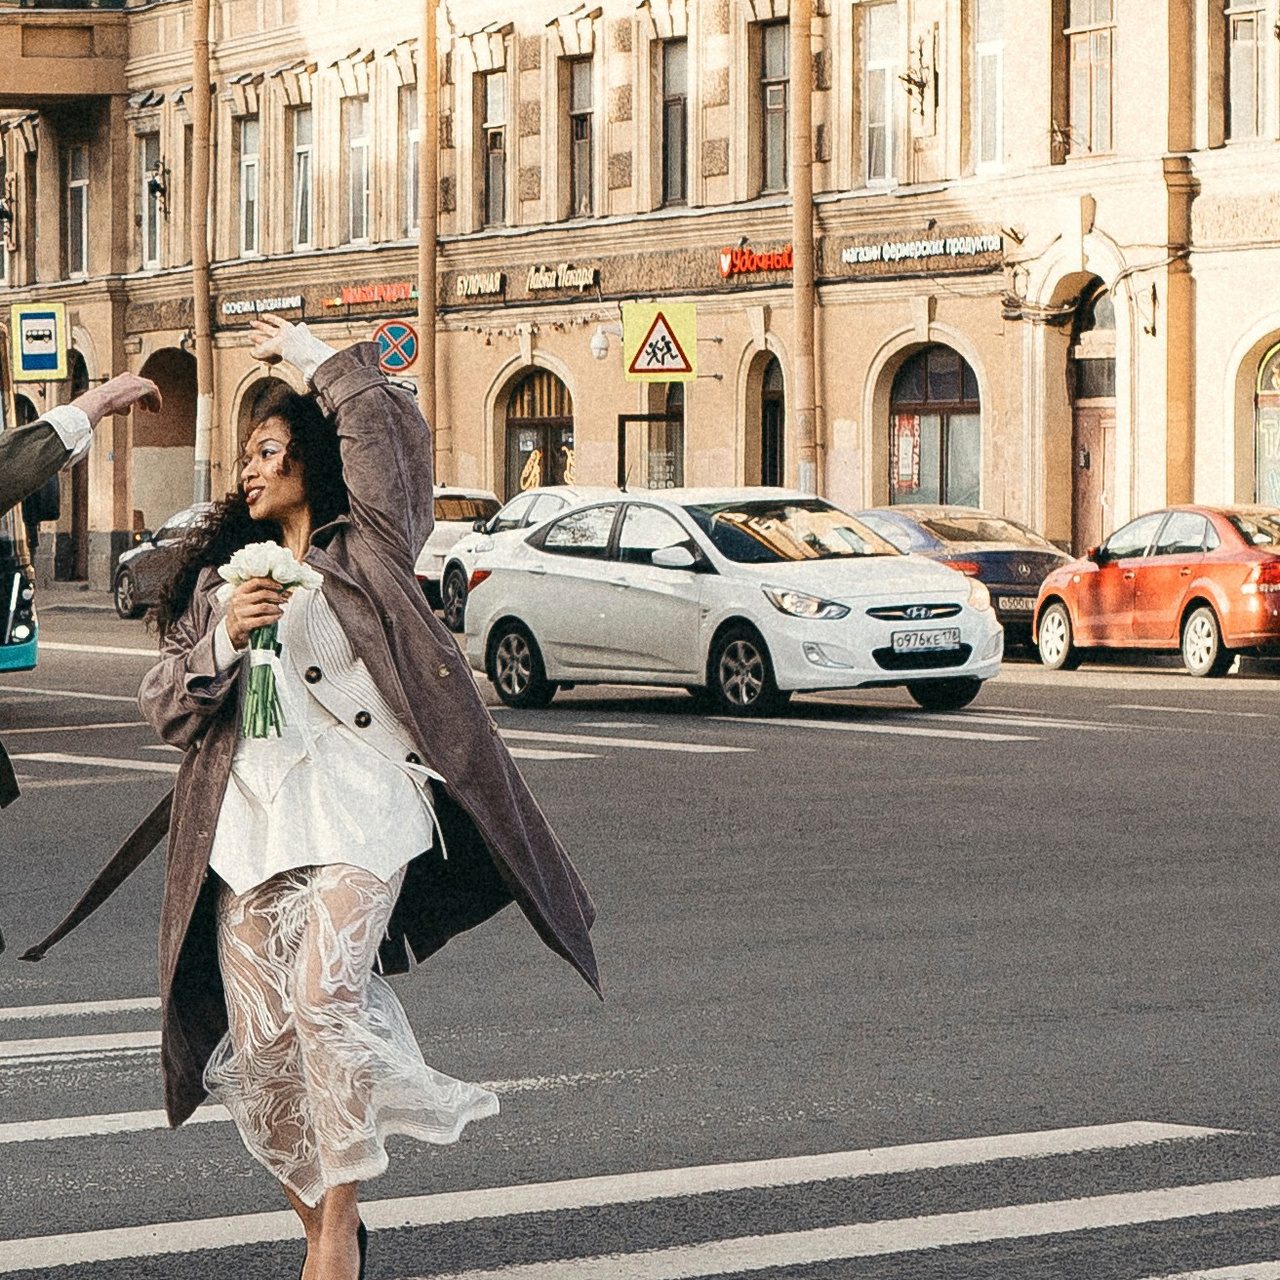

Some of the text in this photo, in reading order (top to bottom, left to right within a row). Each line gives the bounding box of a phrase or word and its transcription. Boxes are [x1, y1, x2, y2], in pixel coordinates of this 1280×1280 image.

[842, 235, 1001, 263] магазин фермерских продуктов
[456, 272, 501, 296] БУЛОЧНАЯ
[526, 265, 557, 292] Лавка
